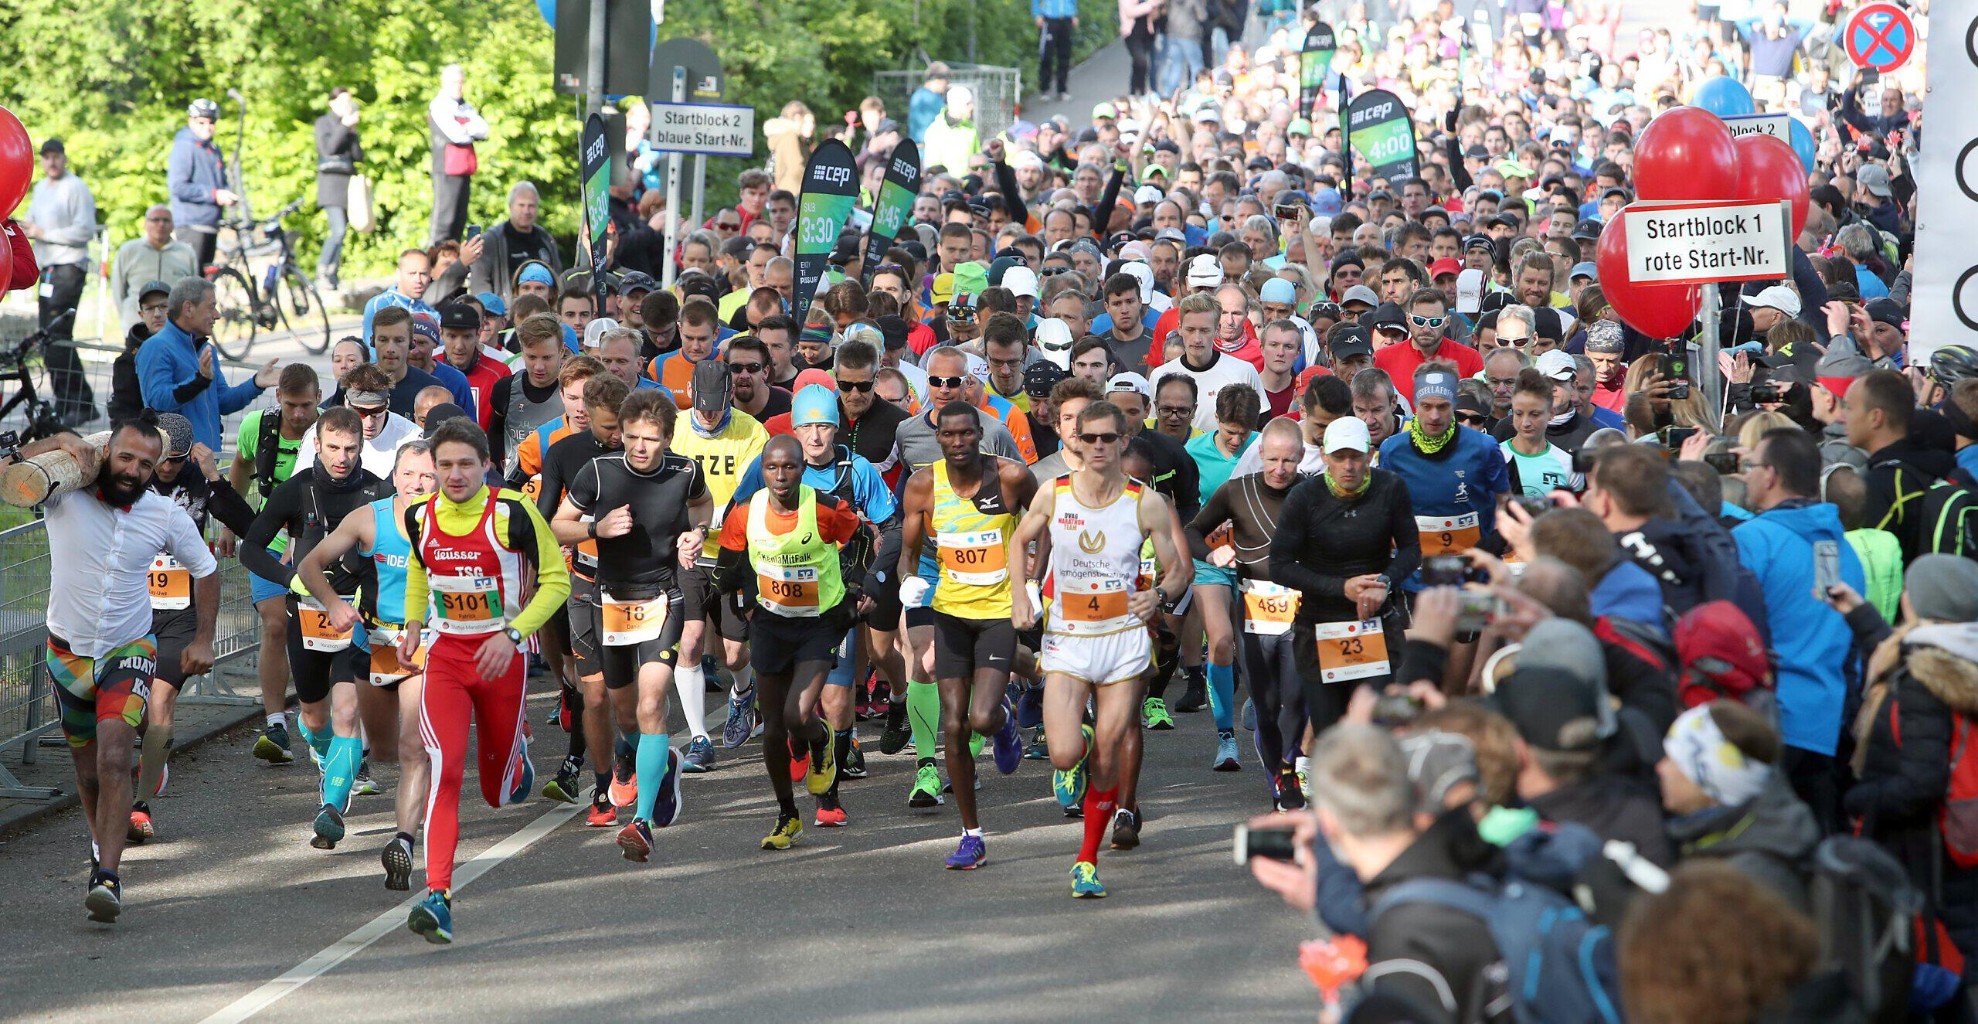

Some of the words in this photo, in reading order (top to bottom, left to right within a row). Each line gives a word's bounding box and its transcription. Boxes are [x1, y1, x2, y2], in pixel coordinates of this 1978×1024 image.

[665, 111, 730, 127] Startblock
[733, 114, 741, 127] 2
[1365, 101, 1392, 120] cep
[658, 130, 691, 144] blaue
[695, 132, 747, 147] Start-Nr.
[1730, 124, 1763, 137] block
[1768, 123, 1776, 136] 2
[592, 133, 604, 161] cep
[1370, 133, 1410, 159] 4:00
[826, 167, 850, 187] cep
[900, 161, 917, 183] cep
[589, 191, 608, 231] 3:30
[876, 201, 901, 230] 3:45
[802, 217, 833, 243] 3:30
[1647, 215, 1746, 239] Startblock
[1753, 214, 1762, 233] 1
[1646, 252, 1682, 271] rote
[1689, 246, 1769, 269] Start-Nr.
[1441, 532, 1452, 547] 9
[434, 547, 481, 561] Teusser
[954, 548, 988, 564] 807
[454, 566, 484, 577] TSG
[1073, 559, 1110, 569] Deutsche
[771, 580, 803, 598] 808
[441, 593, 489, 611] S101
[1088, 596, 1100, 611] 4
[1258, 598, 1288, 613] 489
[1340, 638, 1364, 656] 23
